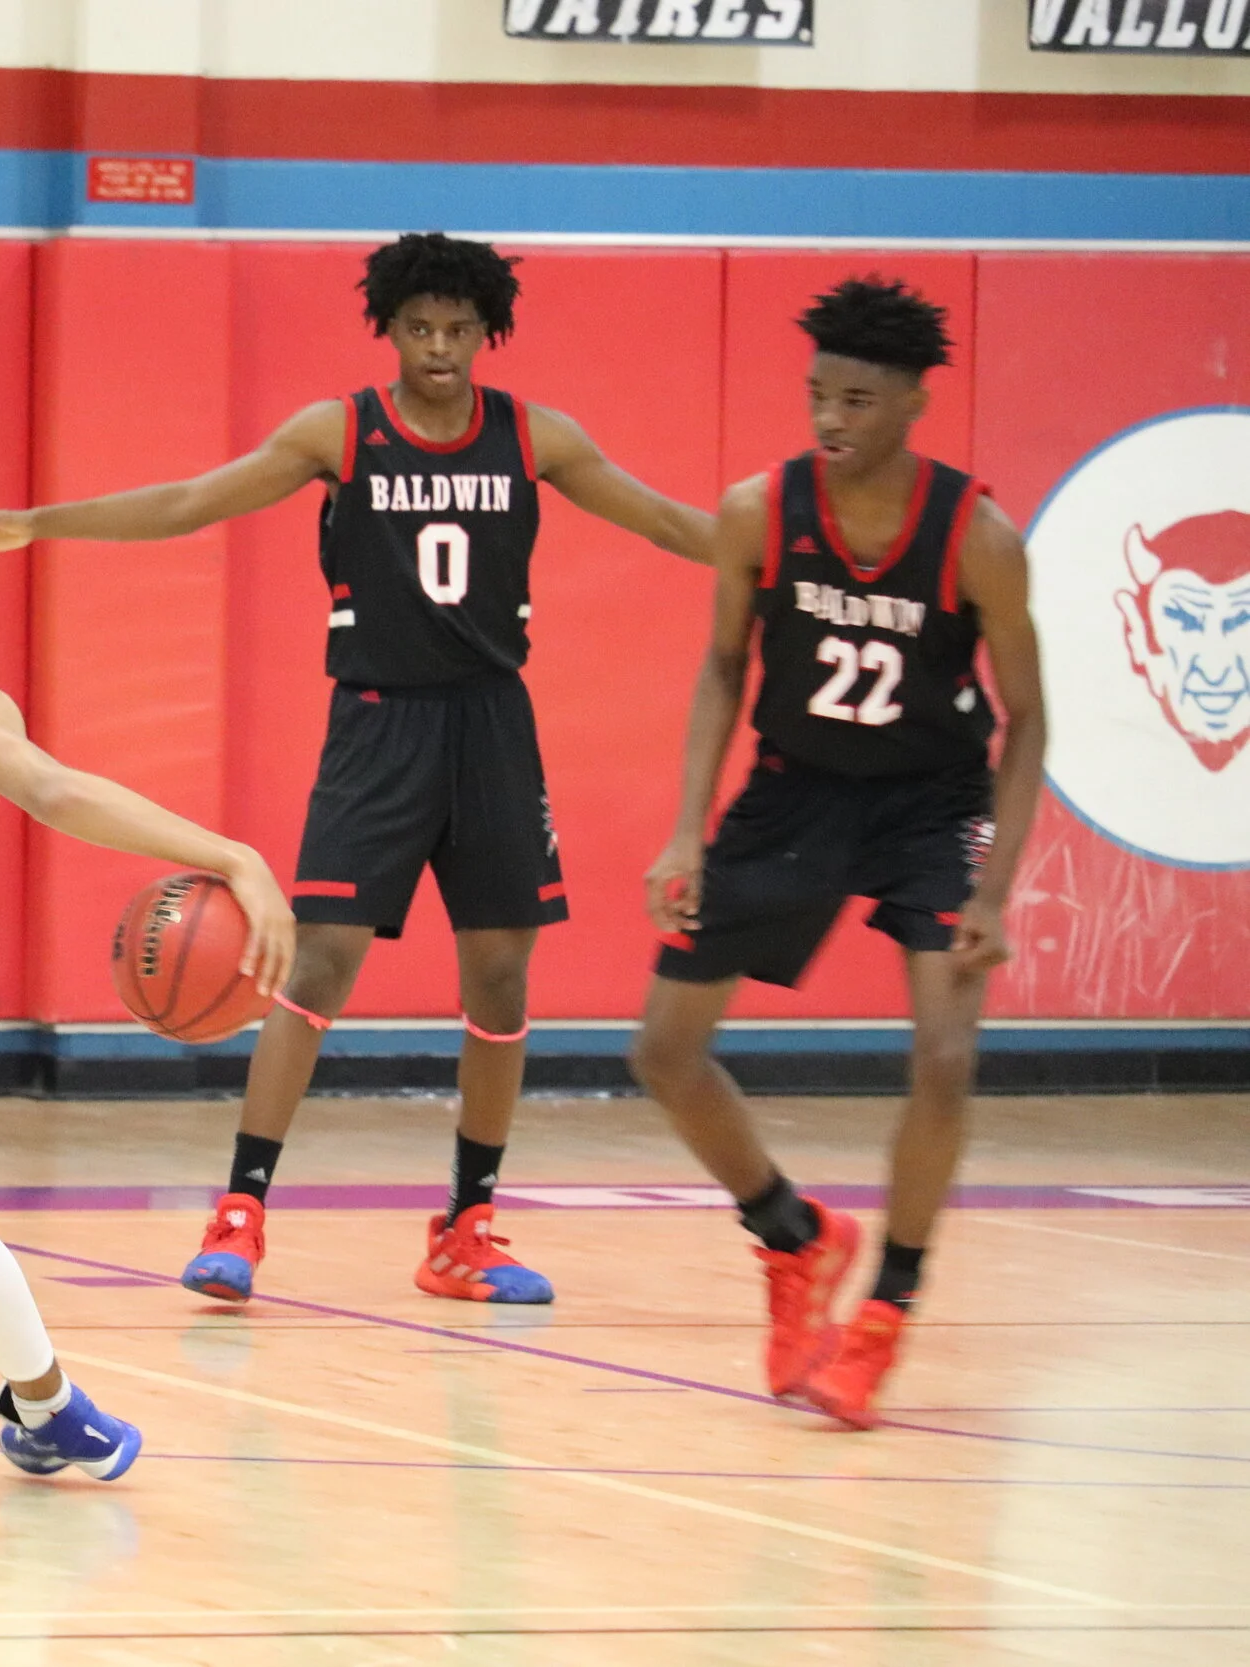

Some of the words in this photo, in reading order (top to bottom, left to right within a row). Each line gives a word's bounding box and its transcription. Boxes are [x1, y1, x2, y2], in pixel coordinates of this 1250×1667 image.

[369, 475, 511, 511] BALDWIN
[417, 523, 469, 605] 0
[807, 636, 903, 726] 22
